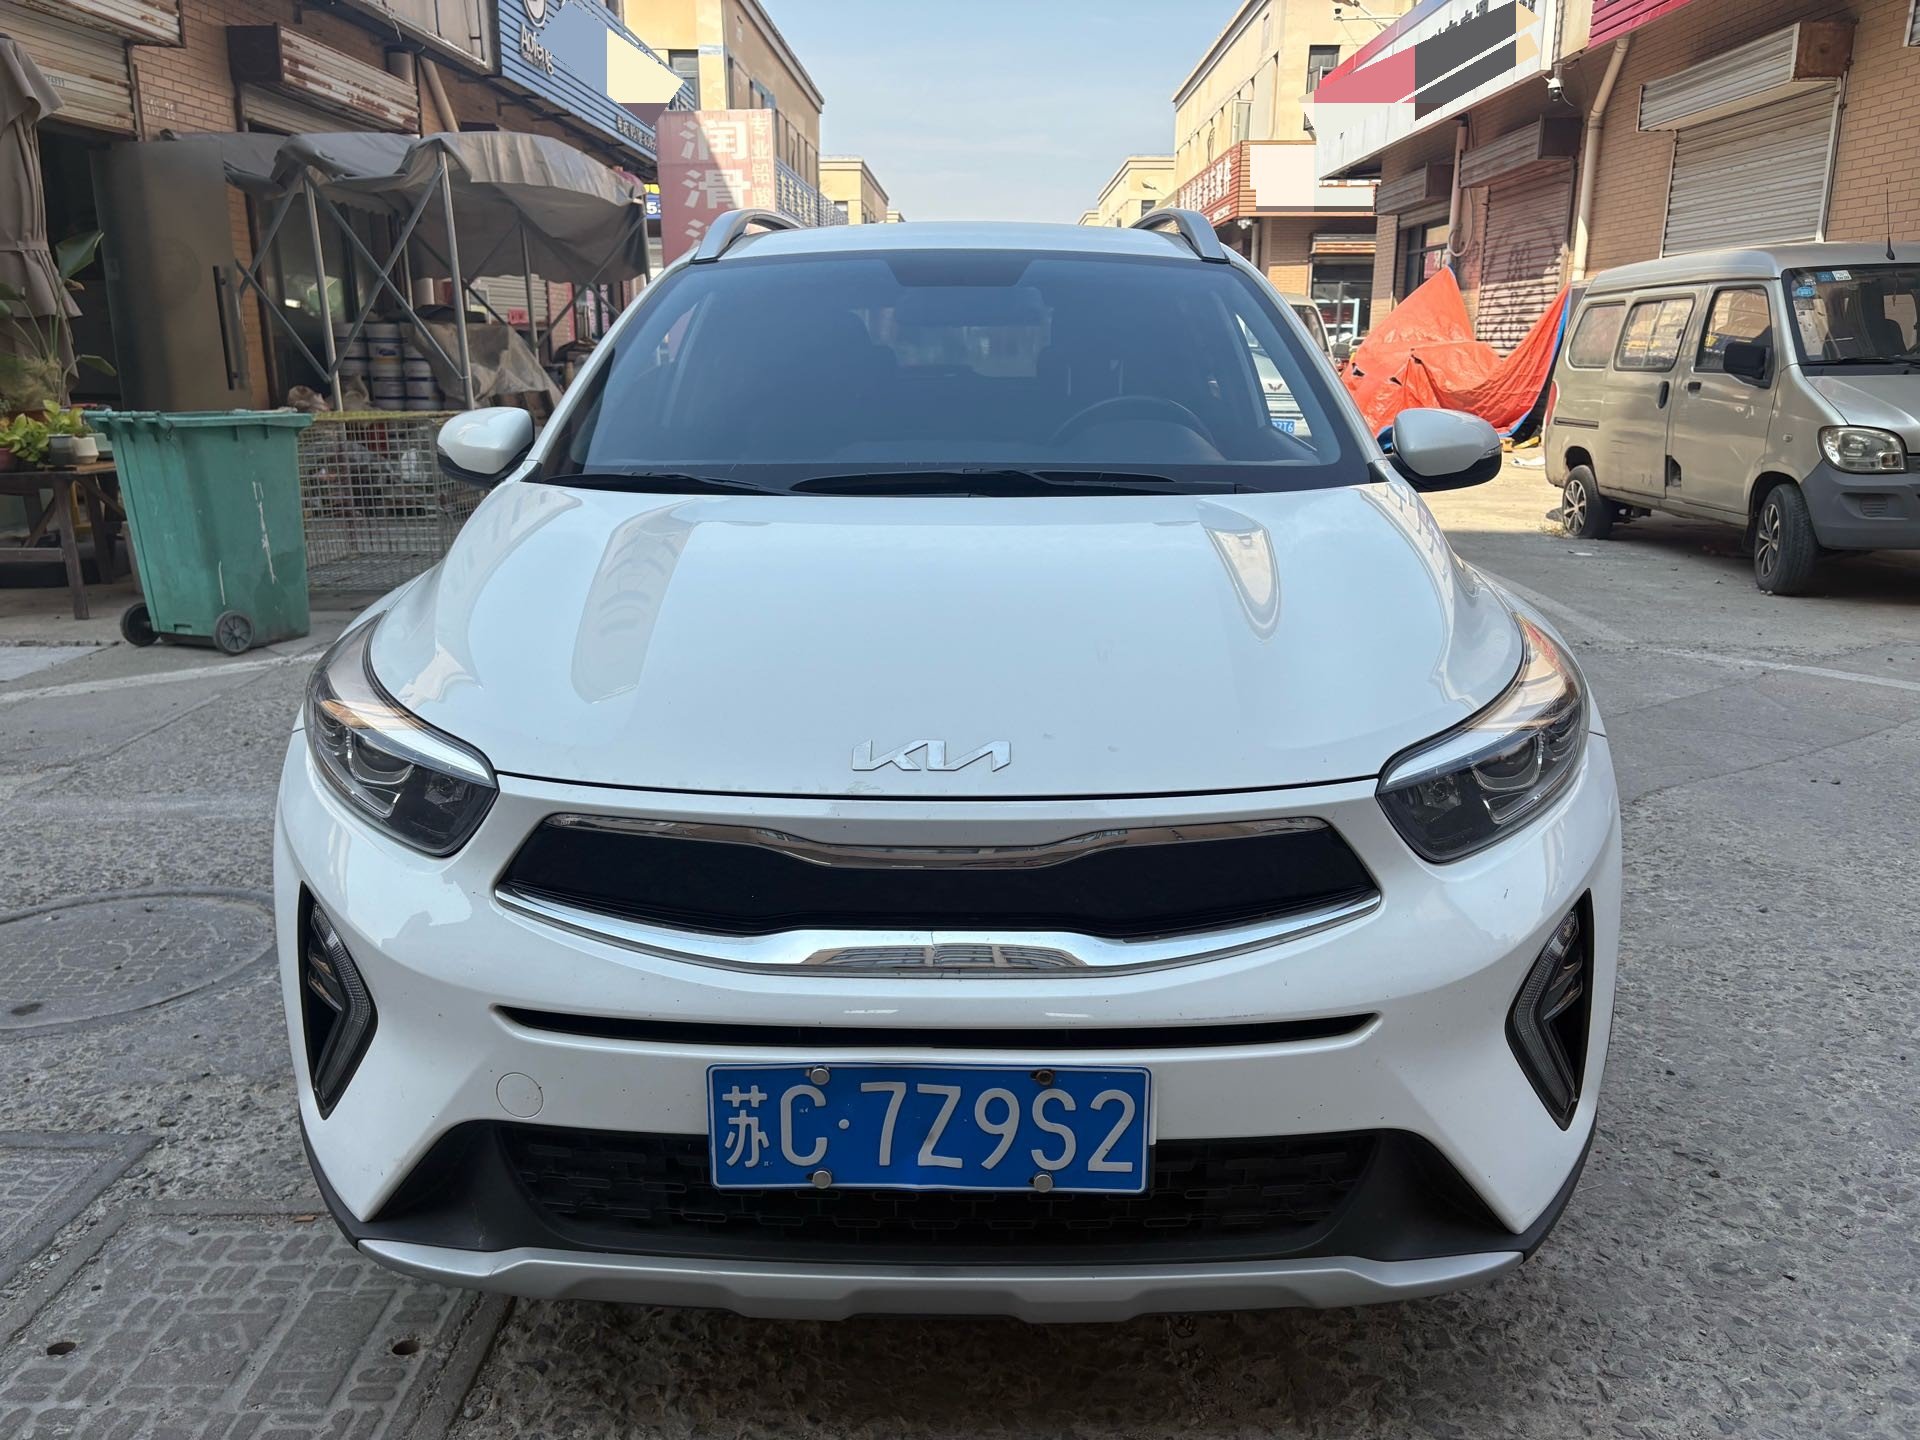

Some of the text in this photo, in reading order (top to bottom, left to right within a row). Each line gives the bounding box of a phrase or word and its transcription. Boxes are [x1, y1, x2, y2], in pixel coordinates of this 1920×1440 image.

[680, 119, 750, 249] 润滑
[852, 739, 1012, 772] KIA
[722, 1081, 1137, 1173] 苏C·7Z9S2
